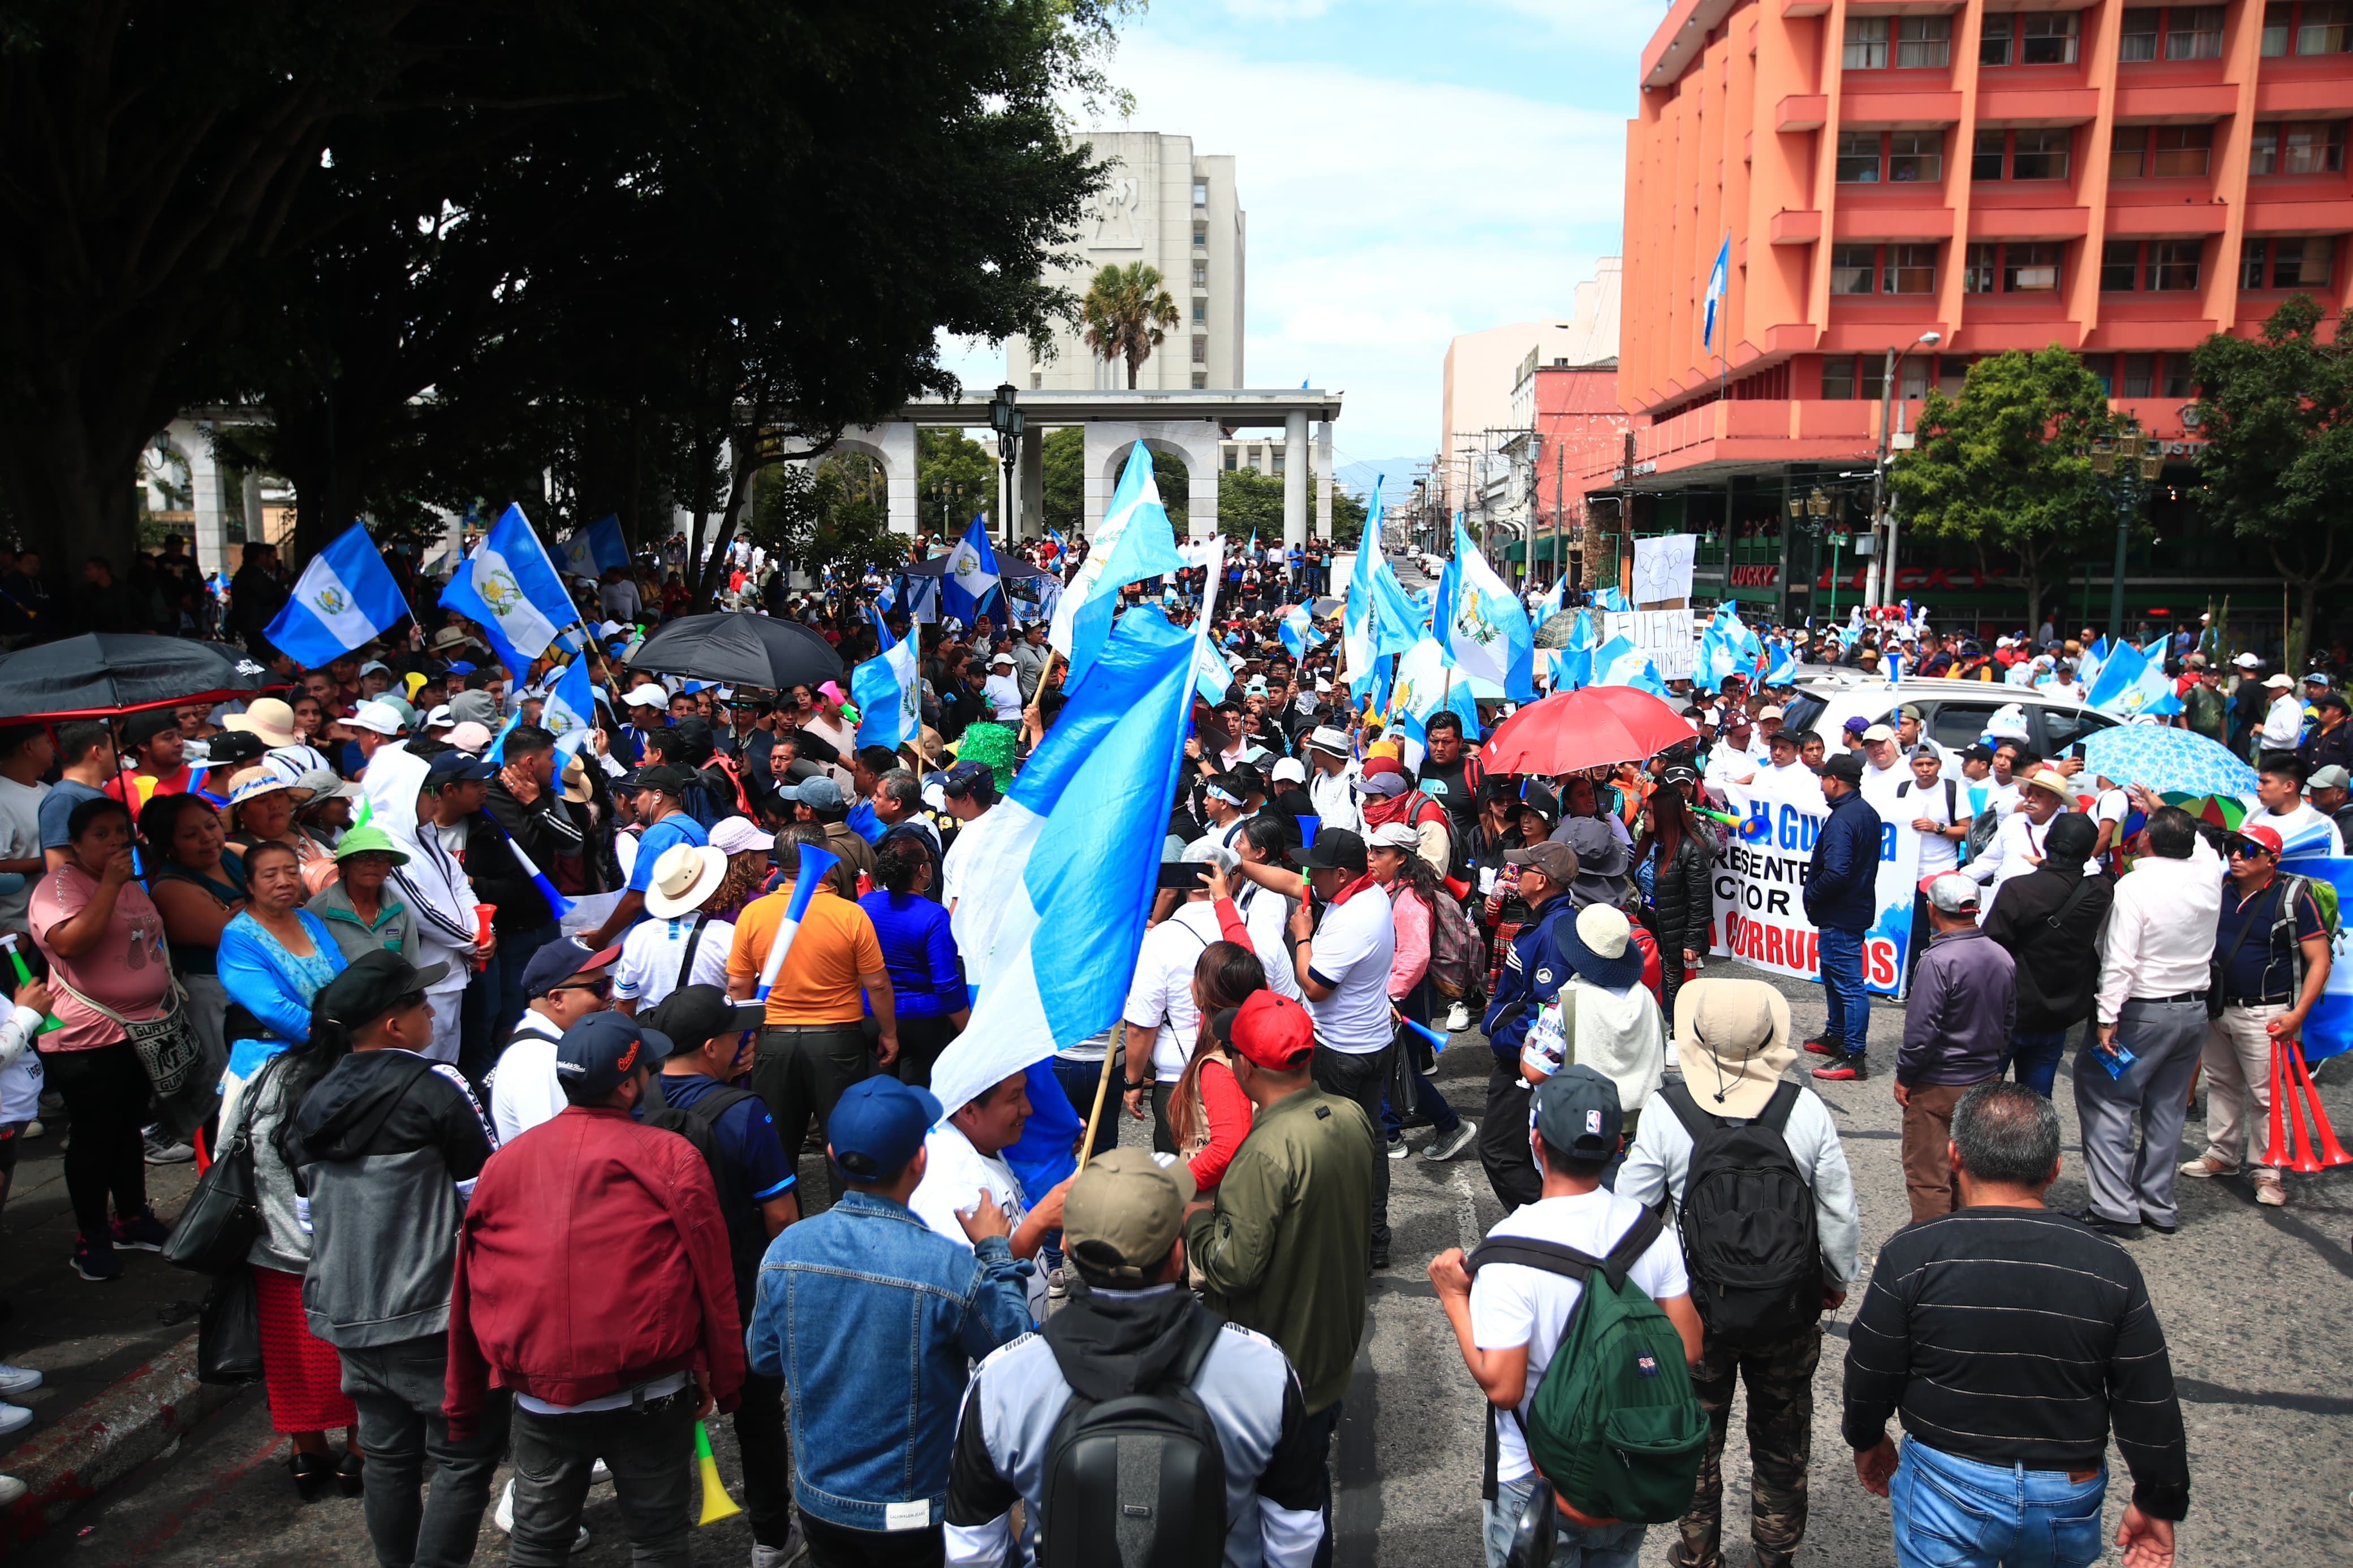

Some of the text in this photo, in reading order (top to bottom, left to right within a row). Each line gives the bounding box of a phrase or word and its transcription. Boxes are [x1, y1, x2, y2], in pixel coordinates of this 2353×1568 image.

[1730, 566, 1780, 586] LUCKY
[1617, 611, 1687, 649] FUERA
[1648, 649, 1692, 675] HINCHE
[1711, 846, 1812, 887] RESENTE
[1712, 876, 1790, 916] CTOR
[1725, 910, 1894, 984] CORRUPS
